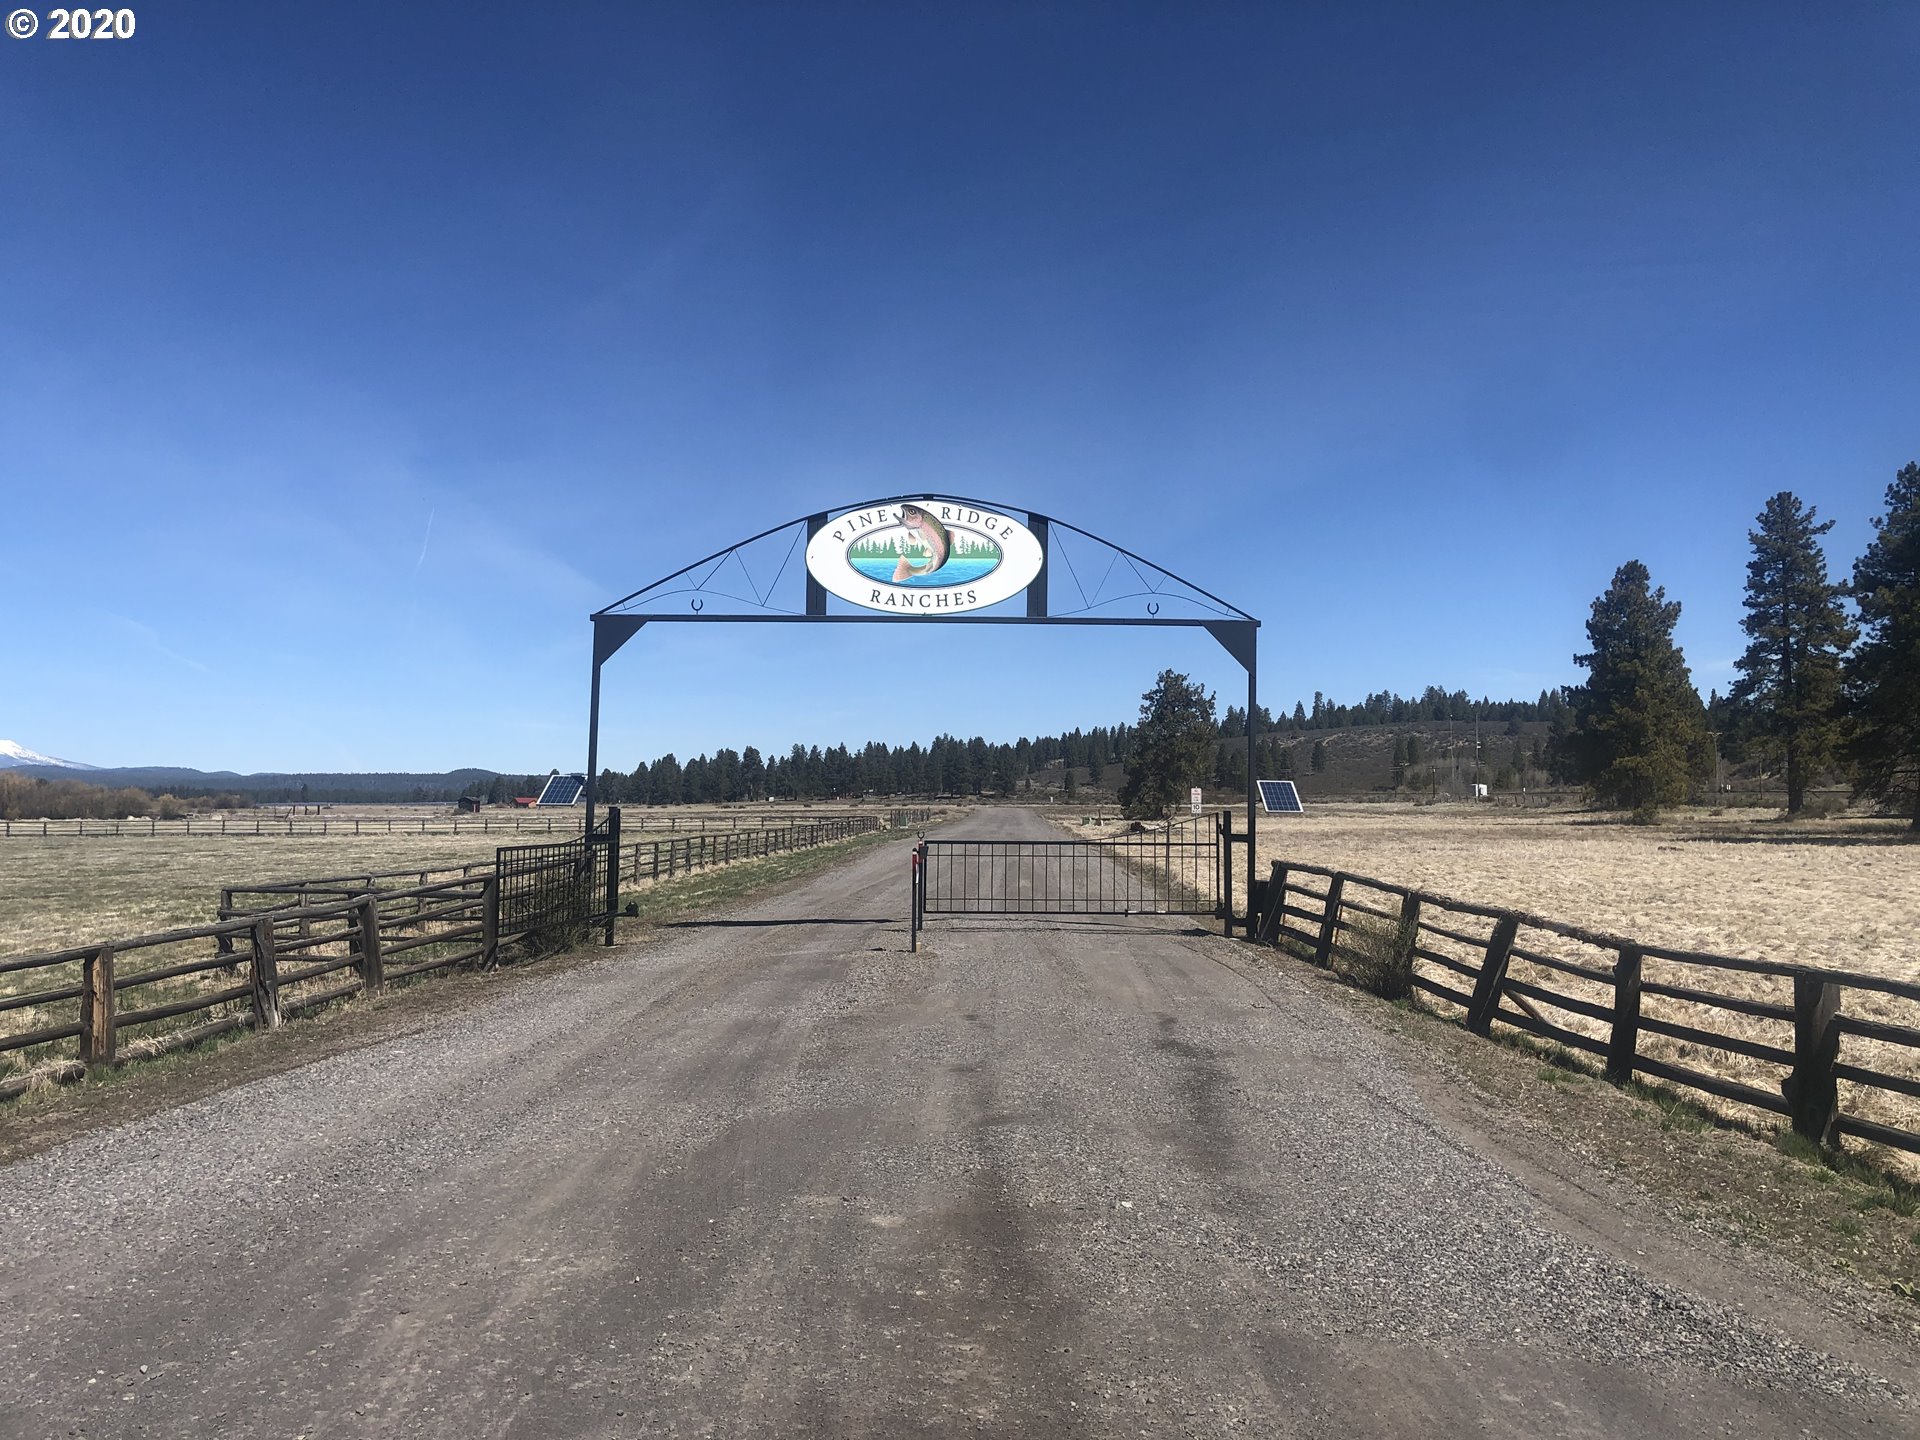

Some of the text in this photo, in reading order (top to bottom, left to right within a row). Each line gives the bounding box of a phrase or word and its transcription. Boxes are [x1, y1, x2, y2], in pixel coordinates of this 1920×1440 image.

[832, 506, 1013, 543] PINE RIDGE
[870, 589, 977, 608] RANCHES
